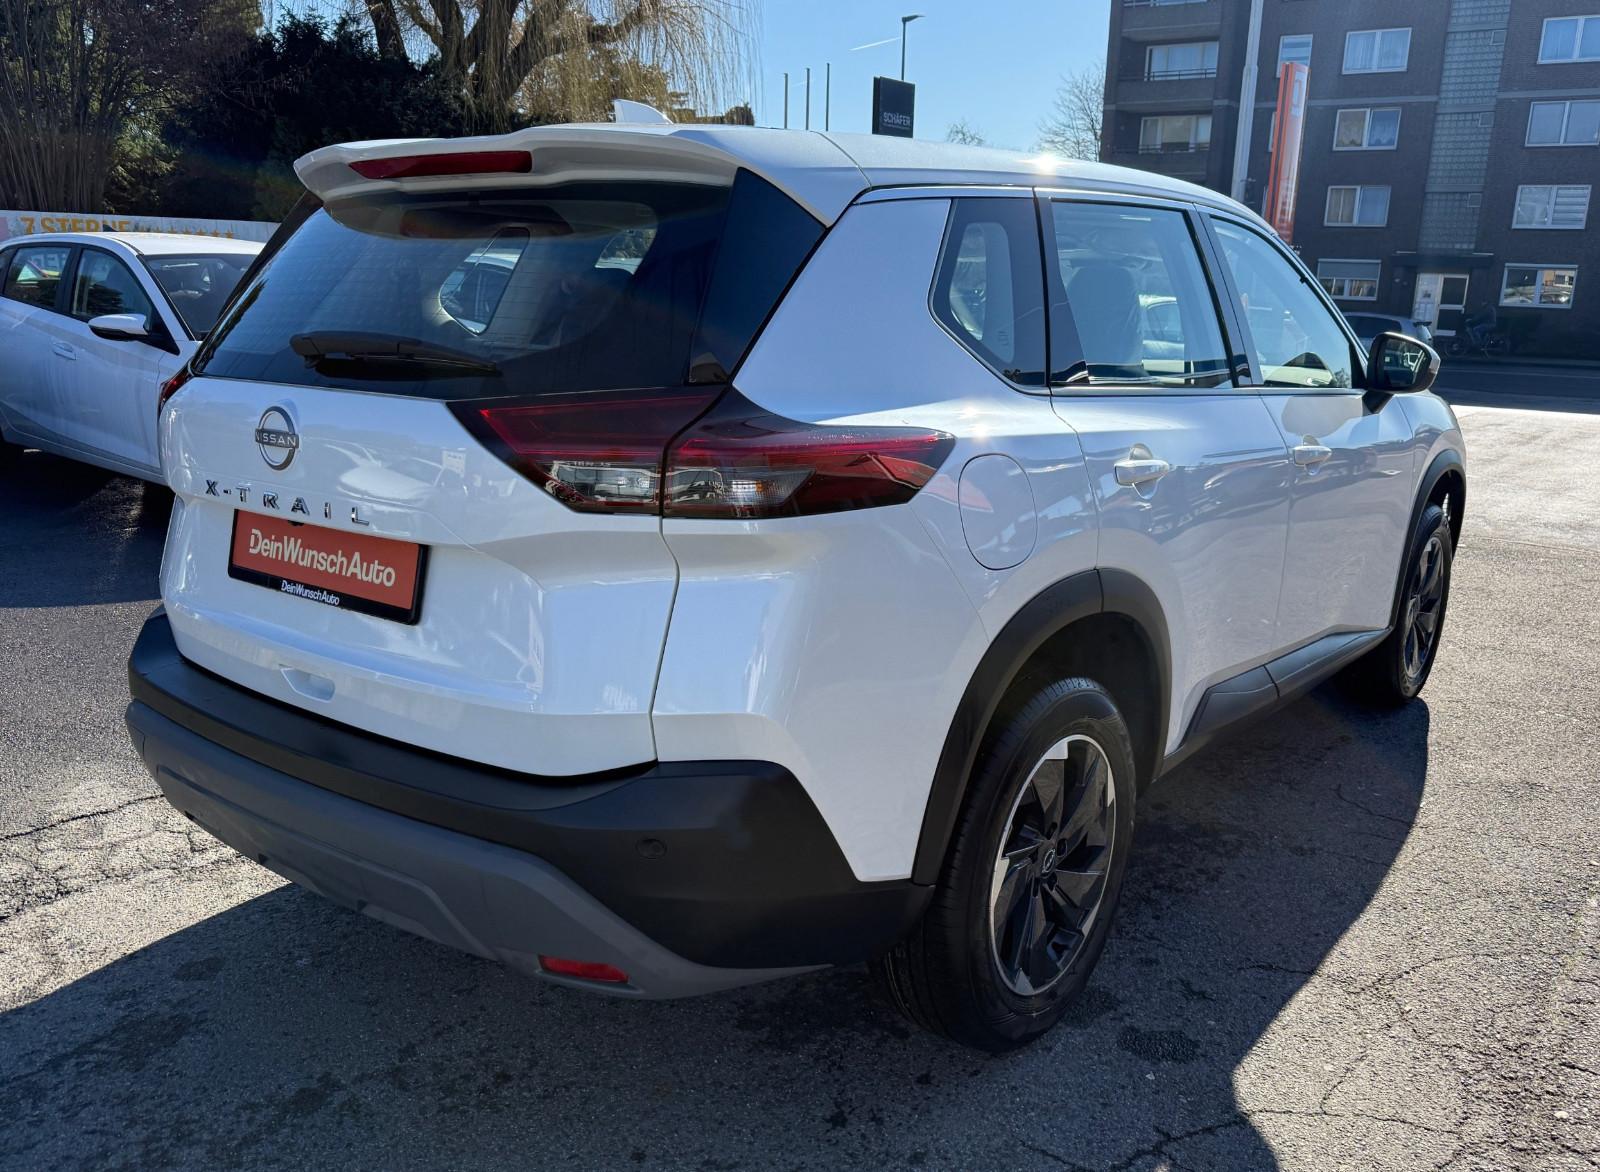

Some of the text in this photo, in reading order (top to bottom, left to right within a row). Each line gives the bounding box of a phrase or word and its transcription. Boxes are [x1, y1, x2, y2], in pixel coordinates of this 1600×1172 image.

[21, 216, 35, 234] 7
[255, 431, 297, 448] NISSAN
[205, 479, 370, 527] X-TRAIL
[248, 528, 396, 588] DeinWunschAuto
[280, 579, 340, 607] DeinWunschAuto
